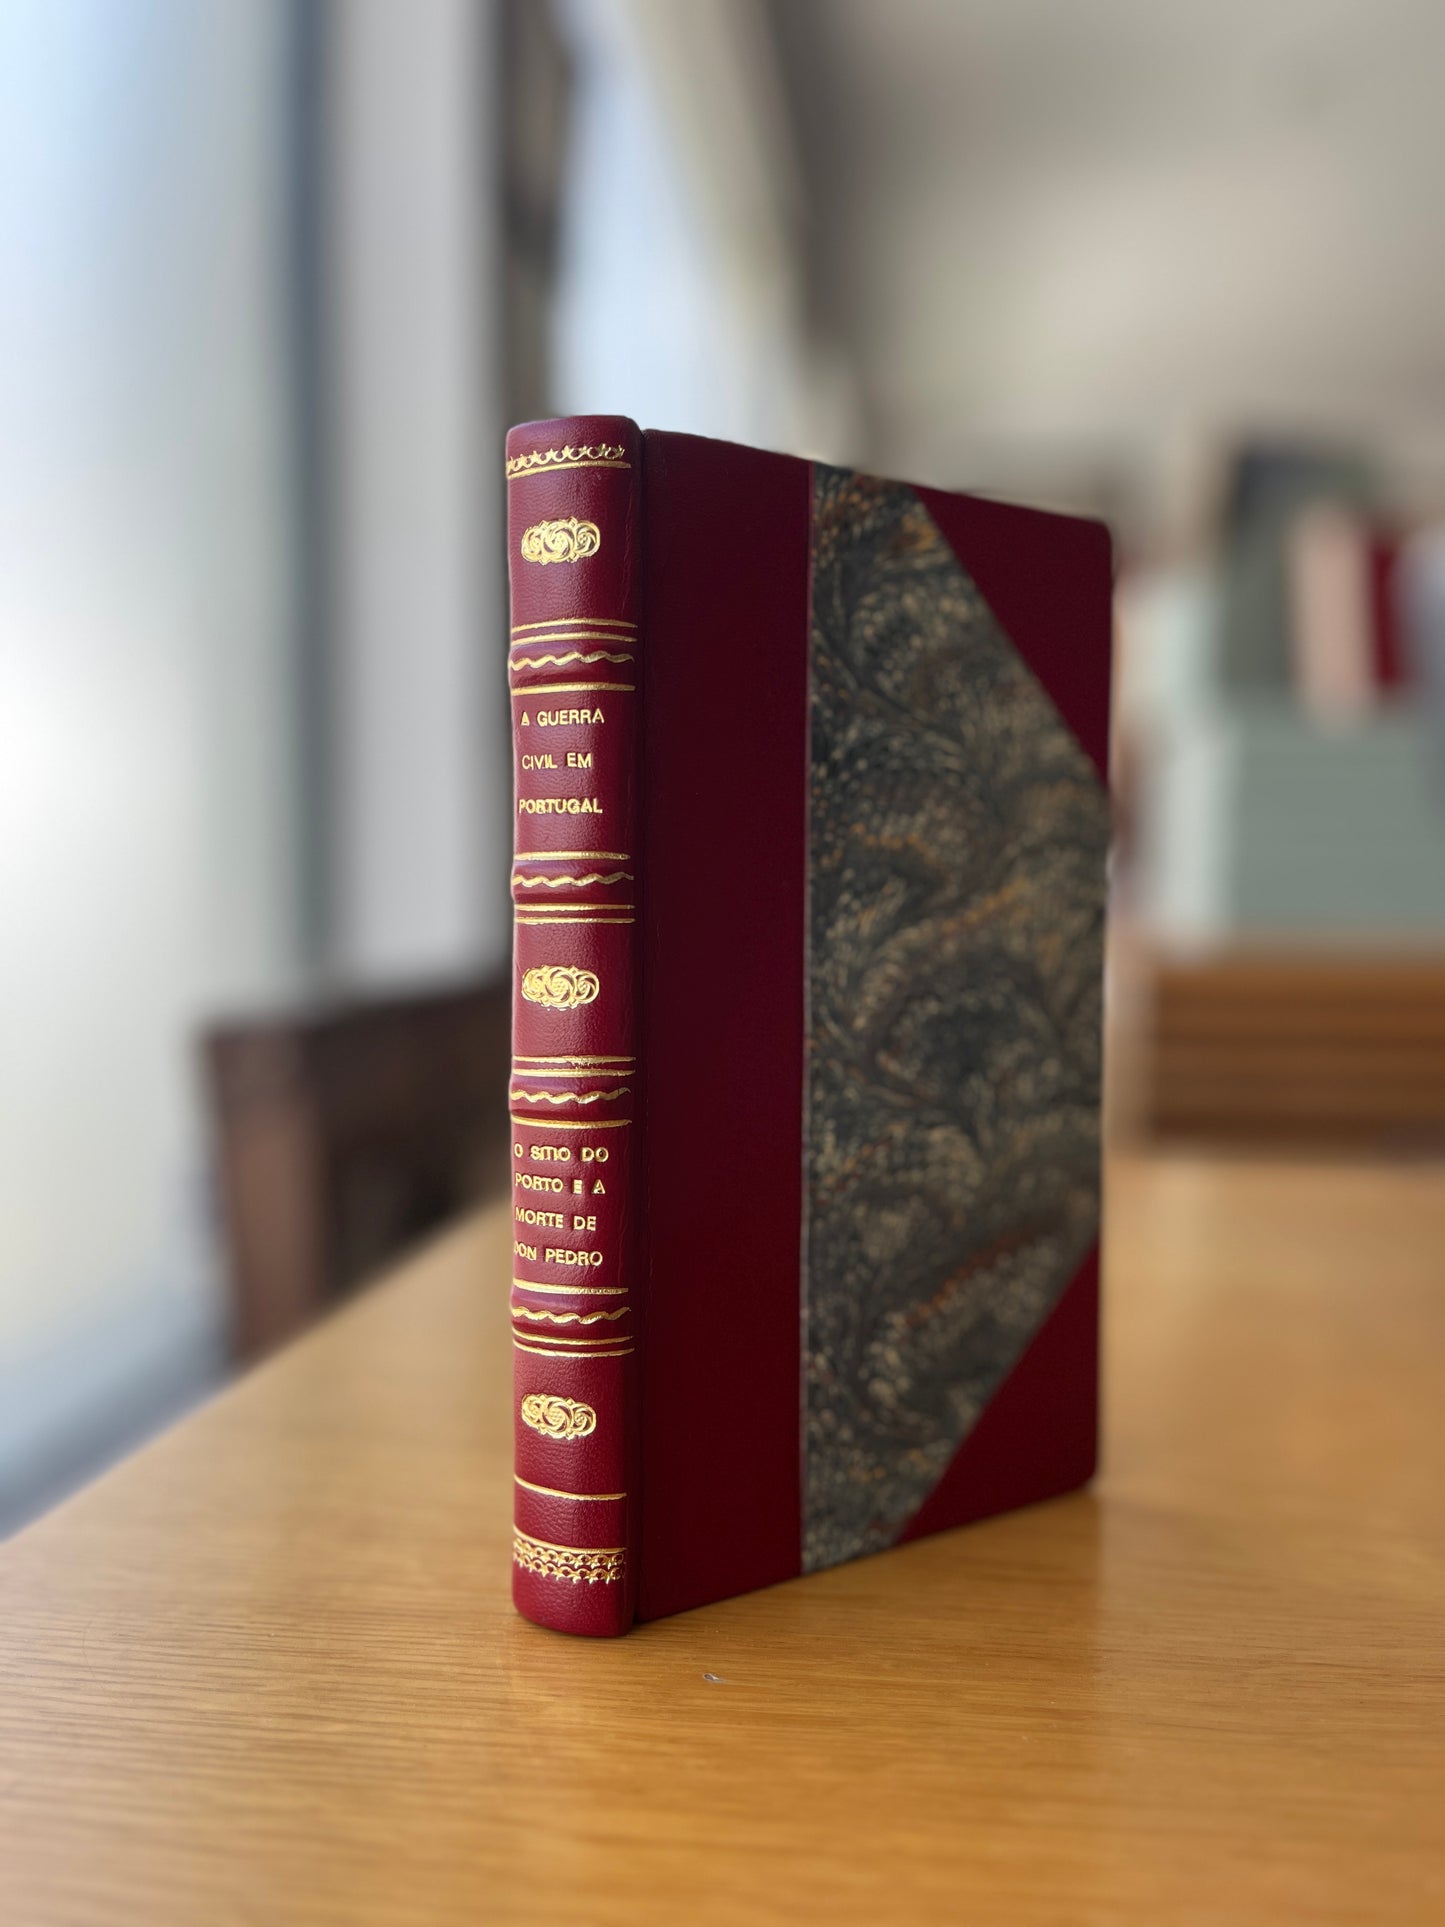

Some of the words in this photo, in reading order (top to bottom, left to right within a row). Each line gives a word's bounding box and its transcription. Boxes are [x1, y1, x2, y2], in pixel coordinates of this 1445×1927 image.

[521, 711, 530, 726] A
[537, 708, 605, 727] GUERRA
[521, 754, 558, 770] CIVIL
[566, 752, 592, 768] EM
[519, 797, 603, 814] PORTUGAL
[514, 1143, 524, 1158] O
[530, 1145, 571, 1161] SITIO
[581, 1146, 609, 1163] DO
[515, 1172, 564, 1193] PORTO
[573, 1179, 583, 1194] E
[592, 1178, 606, 1194] A
[515, 1206, 564, 1229] MORTE
[573, 1215, 597, 1231] DE
[545, 1248, 603, 1266] PEDRO
